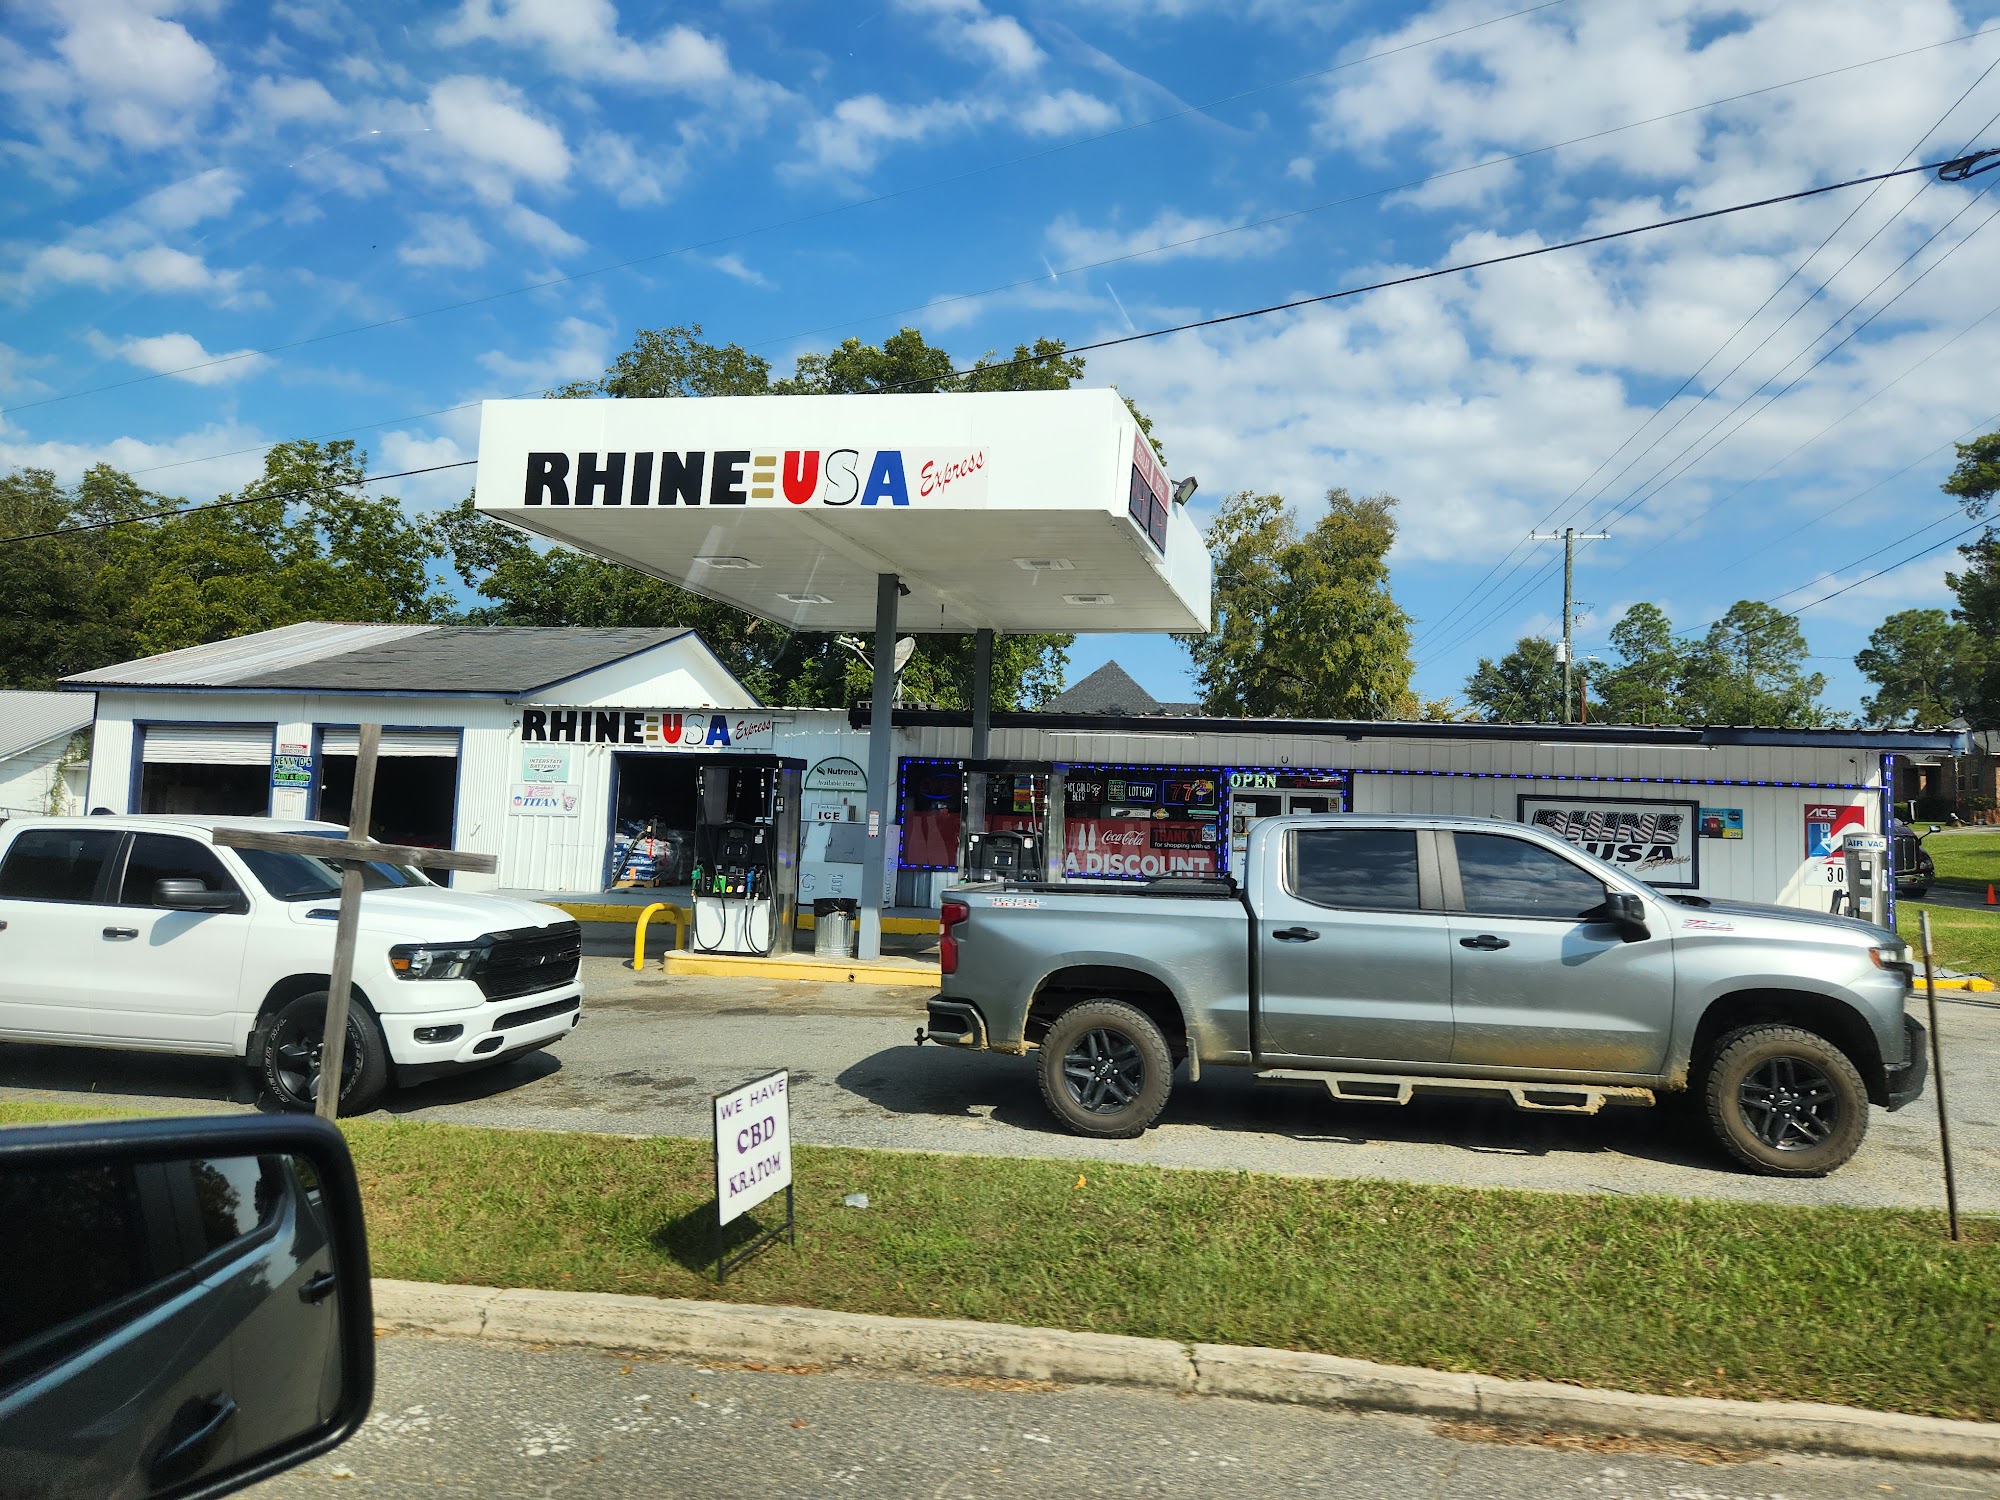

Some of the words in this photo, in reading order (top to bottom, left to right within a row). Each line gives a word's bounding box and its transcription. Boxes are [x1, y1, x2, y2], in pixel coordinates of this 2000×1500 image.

[524, 451, 751, 506] RHINE
[782, 448, 910, 506] USA
[920, 450, 986, 498] Express
[522, 709, 645, 744] RHINE
[662, 713, 731, 746] USA
[735, 719, 772, 741] Express
[827, 767, 858, 776] Nutrena
[1229, 773, 1277, 789] OPEN
[1128, 785, 1154, 798] LOTTERY
[523, 797, 559, 807] TITAN
[818, 811, 840, 820] ICE
[1806, 808, 1837, 818] ACE
[1532, 808, 1685, 845] RHINE
[1163, 842, 1190, 850] shopping
[1585, 842, 1675, 863] USA
[1867, 840, 1884, 848] VAC
[1086, 852, 1210, 878] DISCOUNT
[1634, 854, 1692, 873] Express
[720, 1097, 743, 1120] WE
[750, 1078, 785, 1107] HAVE
[736, 1115, 775, 1155] CBD
